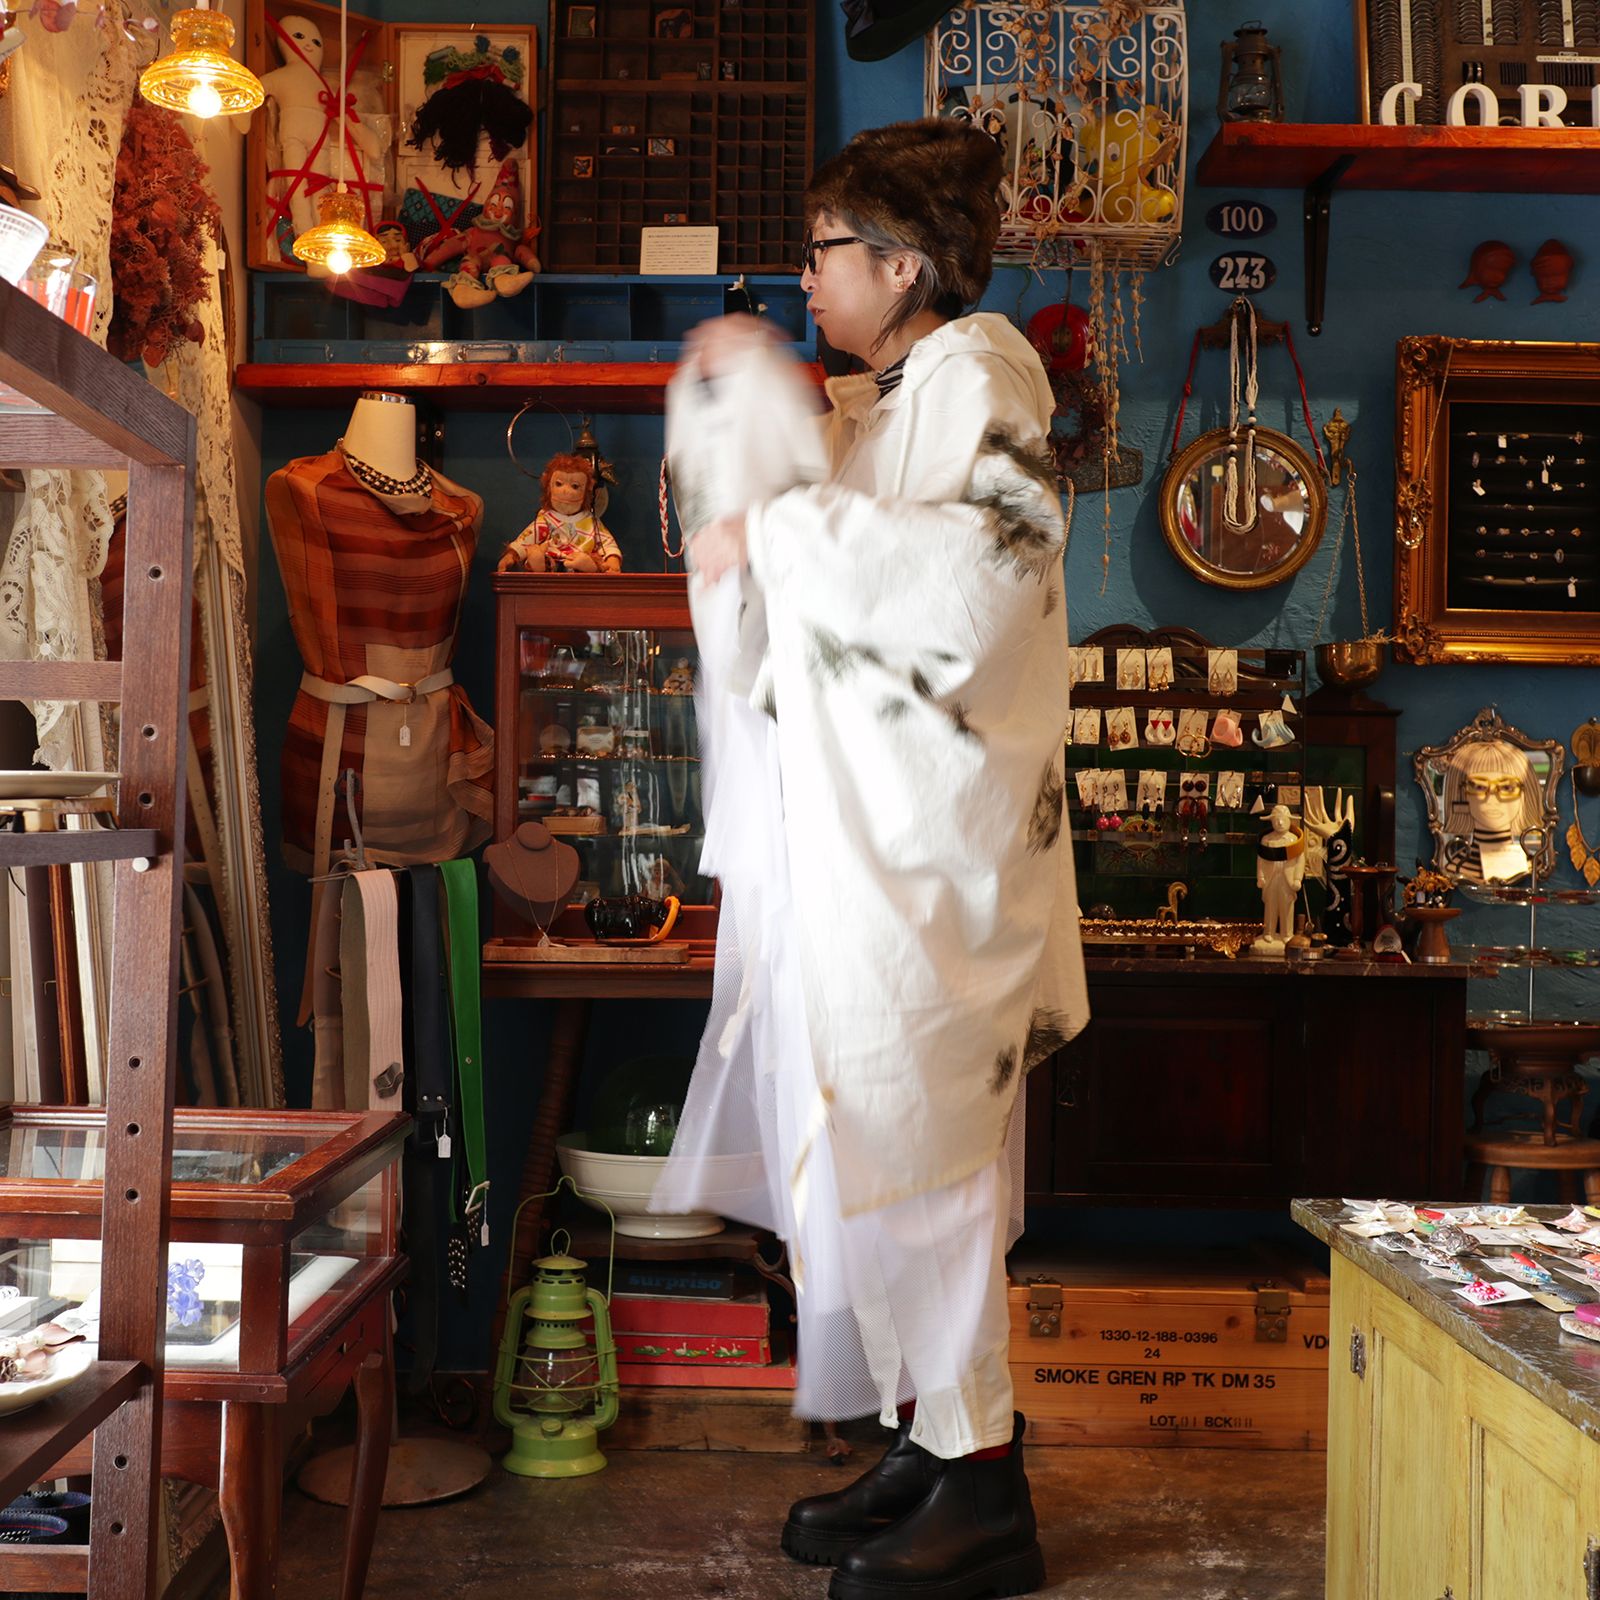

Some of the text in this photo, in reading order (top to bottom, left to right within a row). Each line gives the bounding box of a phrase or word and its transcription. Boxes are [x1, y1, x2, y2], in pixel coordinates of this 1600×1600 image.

[1220, 206, 1264, 232] 100
[1218, 257, 1266, 289] 243
[1100, 1330, 1218, 1344] 1330-12-188-0396
[1303, 1334, 1329, 1350] VD
[1144, 1348, 1161, 1359] 24
[1034, 1368, 1276, 1389] SMOKE GREN RP TK DM 35
[1140, 1393, 1159, 1404] RP
[1149, 1415, 1177, 1427] LOT
[1204, 1416, 1233, 1428] BCK
